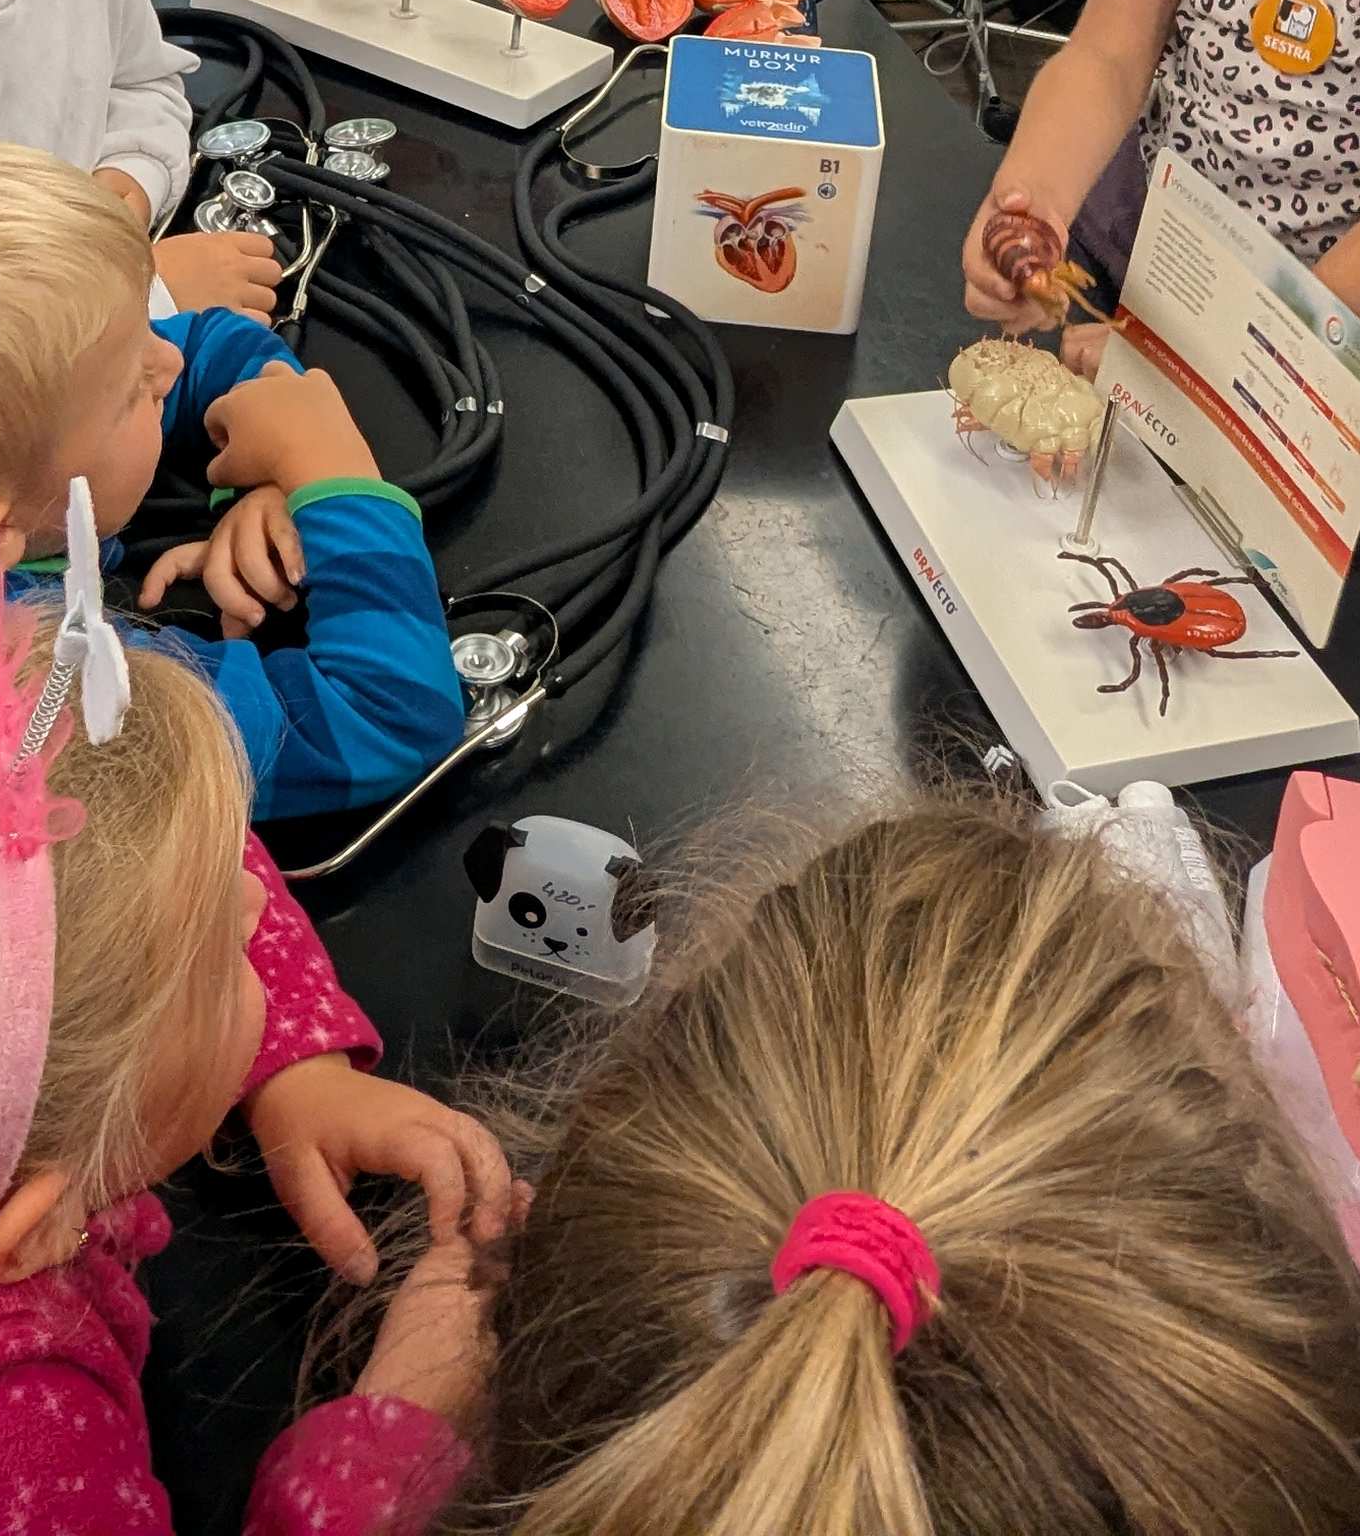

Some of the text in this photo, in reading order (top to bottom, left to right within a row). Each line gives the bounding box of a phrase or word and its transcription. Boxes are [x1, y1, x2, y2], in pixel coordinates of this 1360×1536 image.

[724, 47, 821, 64] MURMUR
[1263, 34, 1312, 63] SESTRA
[749, 59, 797, 72] BOX
[820, 158, 840, 175] B1
[1112, 382, 1177, 447] BRAVECTO
[913, 547, 957, 615] BRAVECTO
